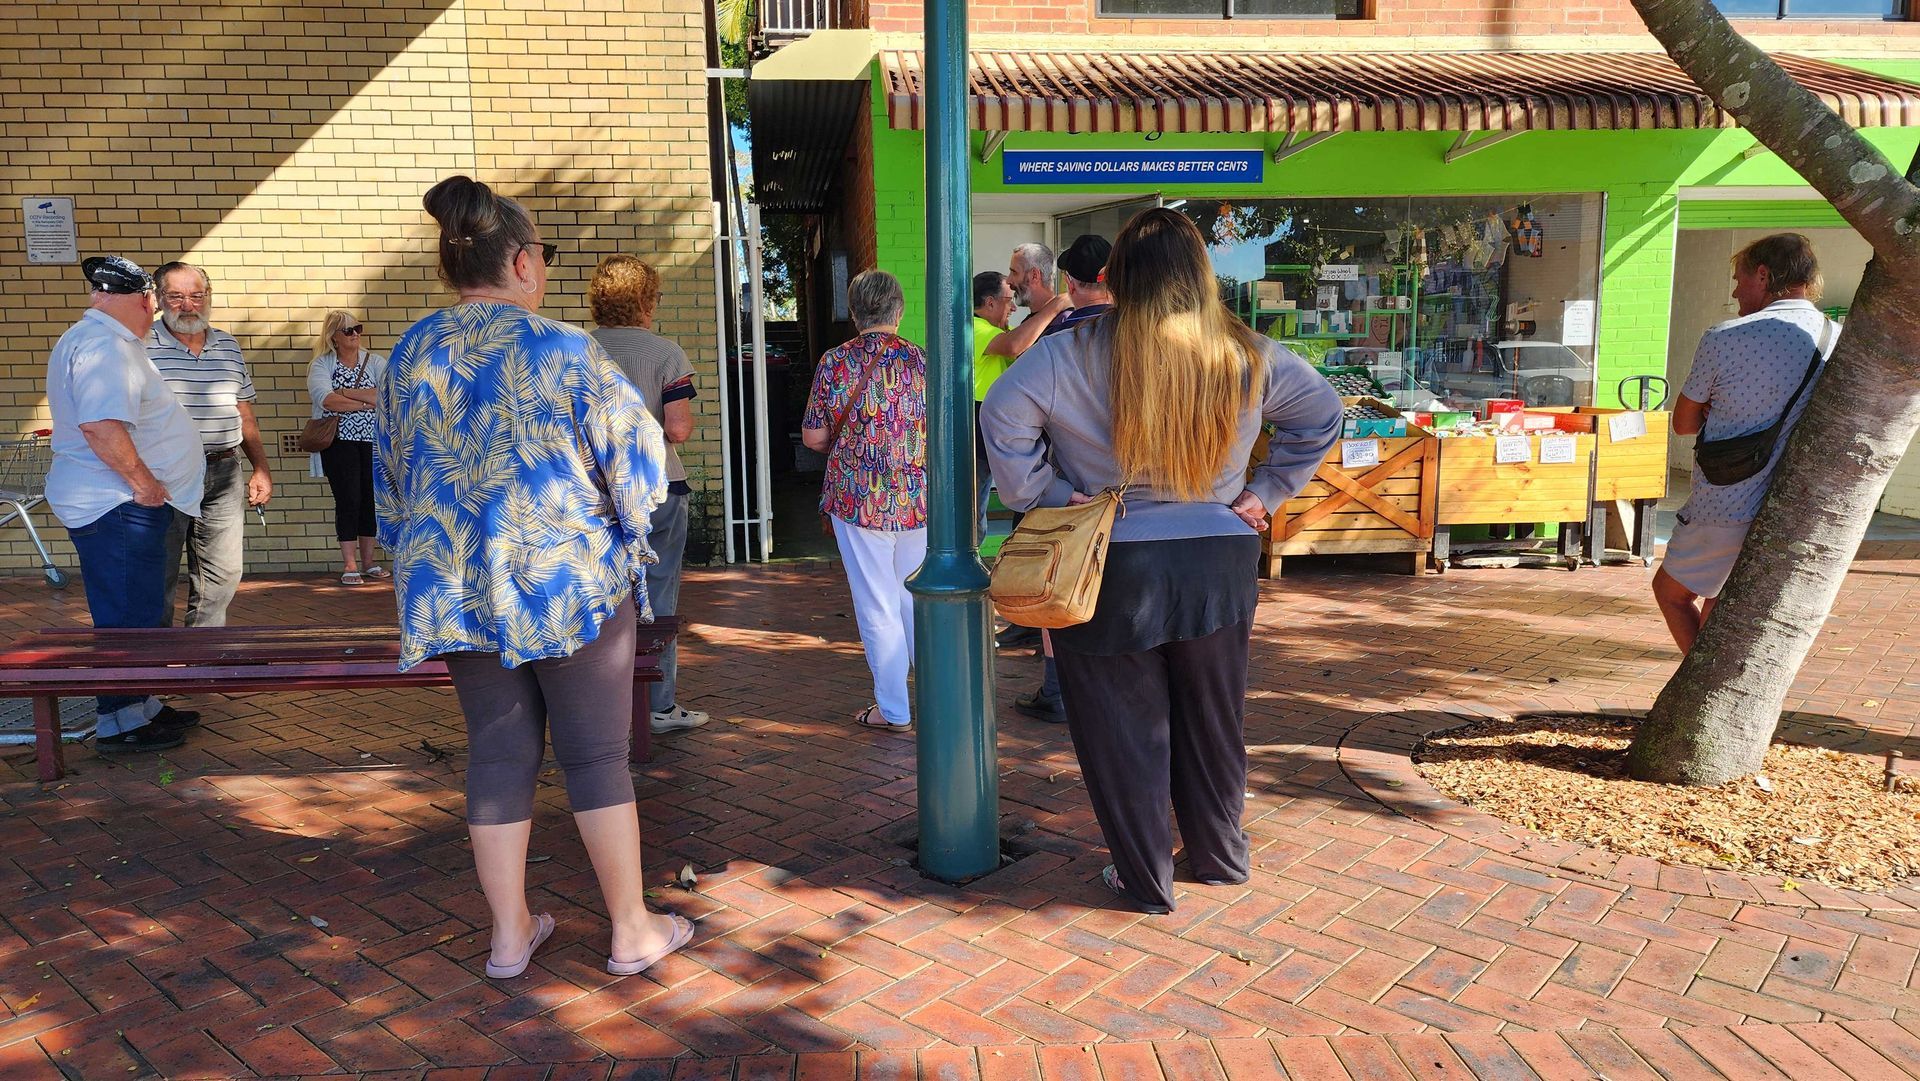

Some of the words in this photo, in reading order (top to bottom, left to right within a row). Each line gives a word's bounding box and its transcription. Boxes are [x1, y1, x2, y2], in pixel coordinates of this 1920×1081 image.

[1019, 161, 1055, 172] WHERE
[1056, 161, 1092, 172] SAVING
[1094, 161, 1139, 172] DOLLARS
[1141, 161, 1176, 172] MAKES
[1177, 161, 1214, 171] BETTER
[1216, 161, 1248, 171] CENTS
